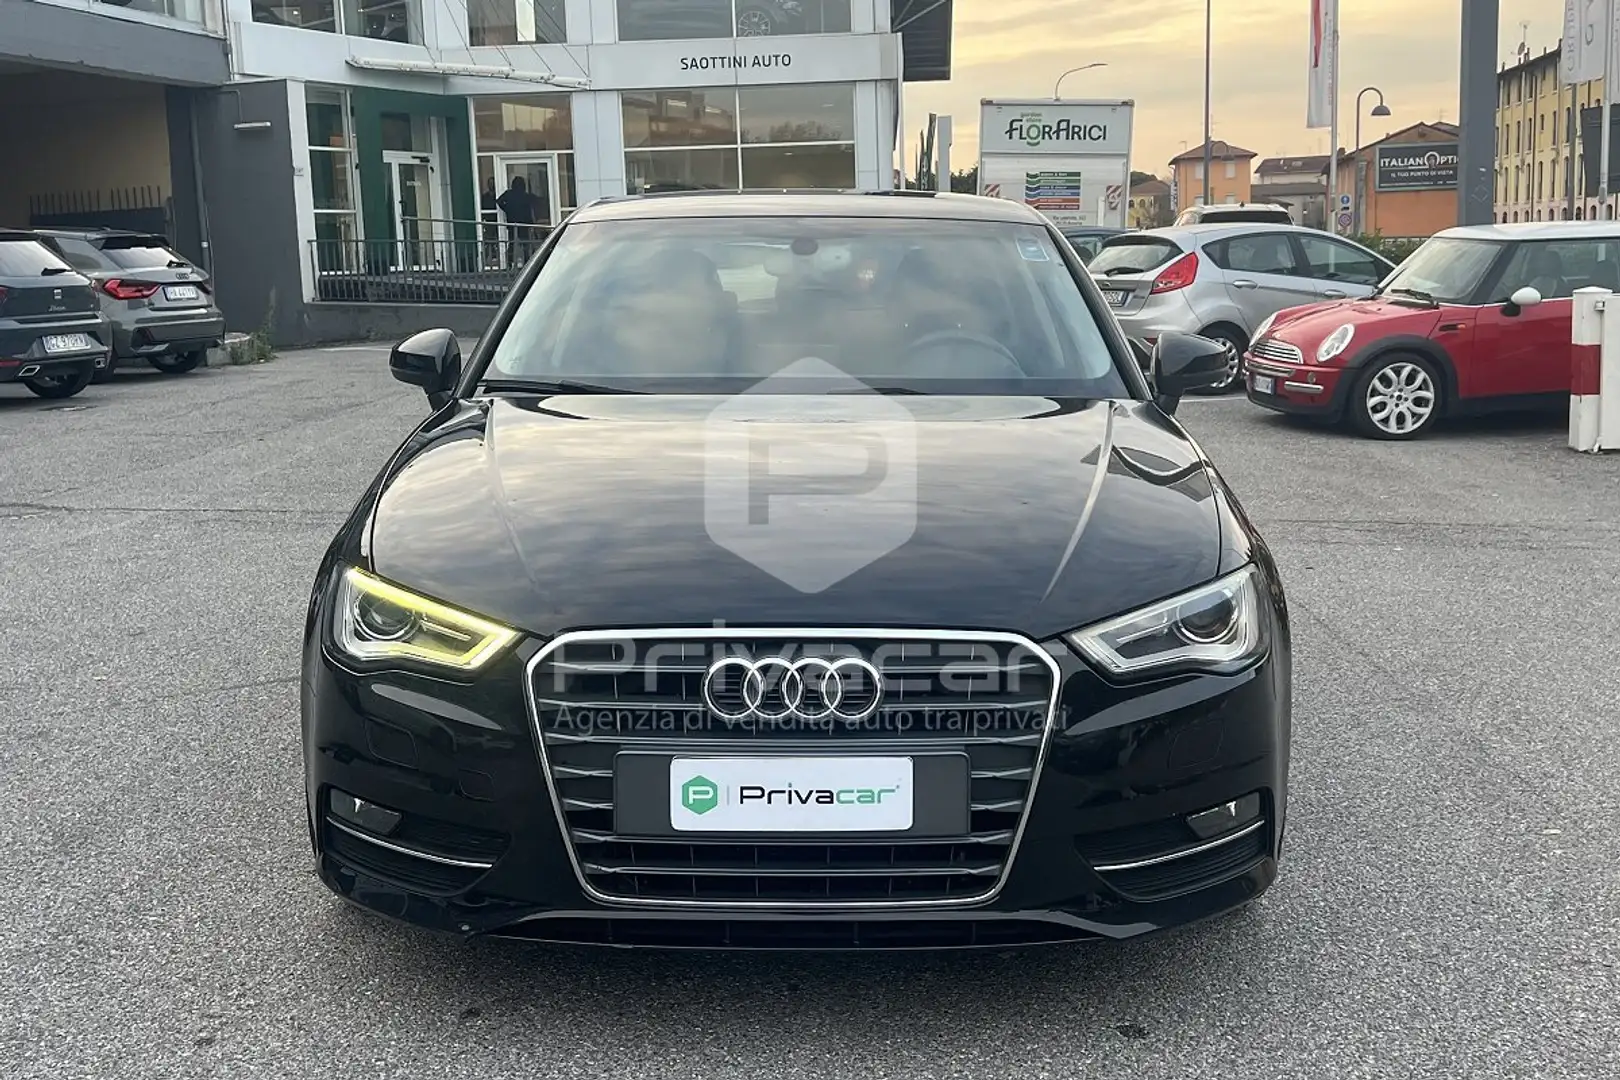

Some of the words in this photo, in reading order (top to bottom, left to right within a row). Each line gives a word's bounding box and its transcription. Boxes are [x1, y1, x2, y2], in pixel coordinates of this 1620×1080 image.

[680, 56, 747, 70] SAOTTINI
[752, 54, 791, 68] AUTO
[739, 783, 895, 805] Privacar
